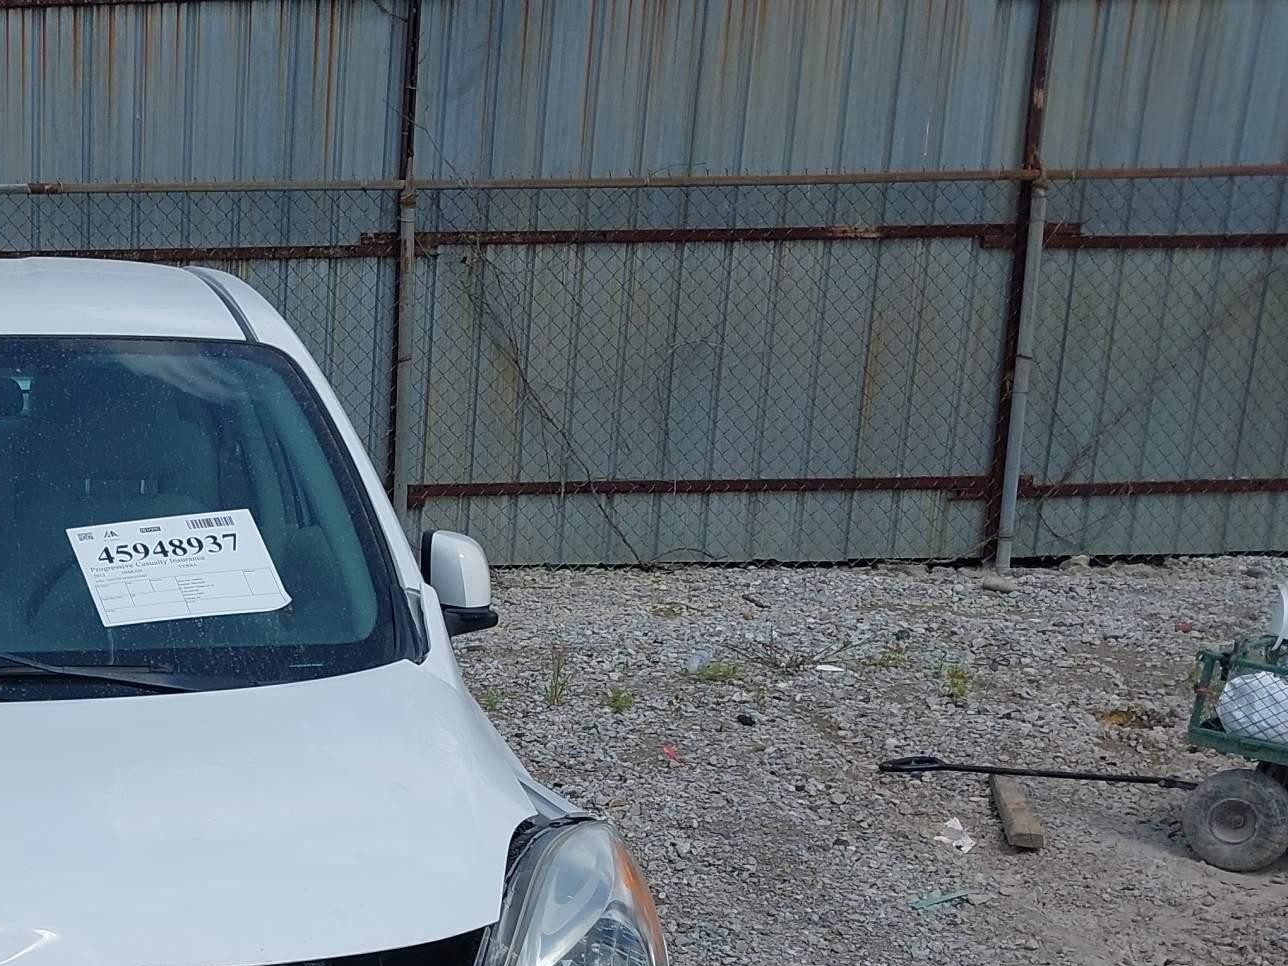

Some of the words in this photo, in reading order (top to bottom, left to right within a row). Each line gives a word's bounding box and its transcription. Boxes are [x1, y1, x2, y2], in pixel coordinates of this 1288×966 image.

[98, 533, 237, 564] 45948937
[89, 563, 134, 574] Progressive
[135, 558, 168, 568] Casualty
[169, 555, 206, 565] Insurance
